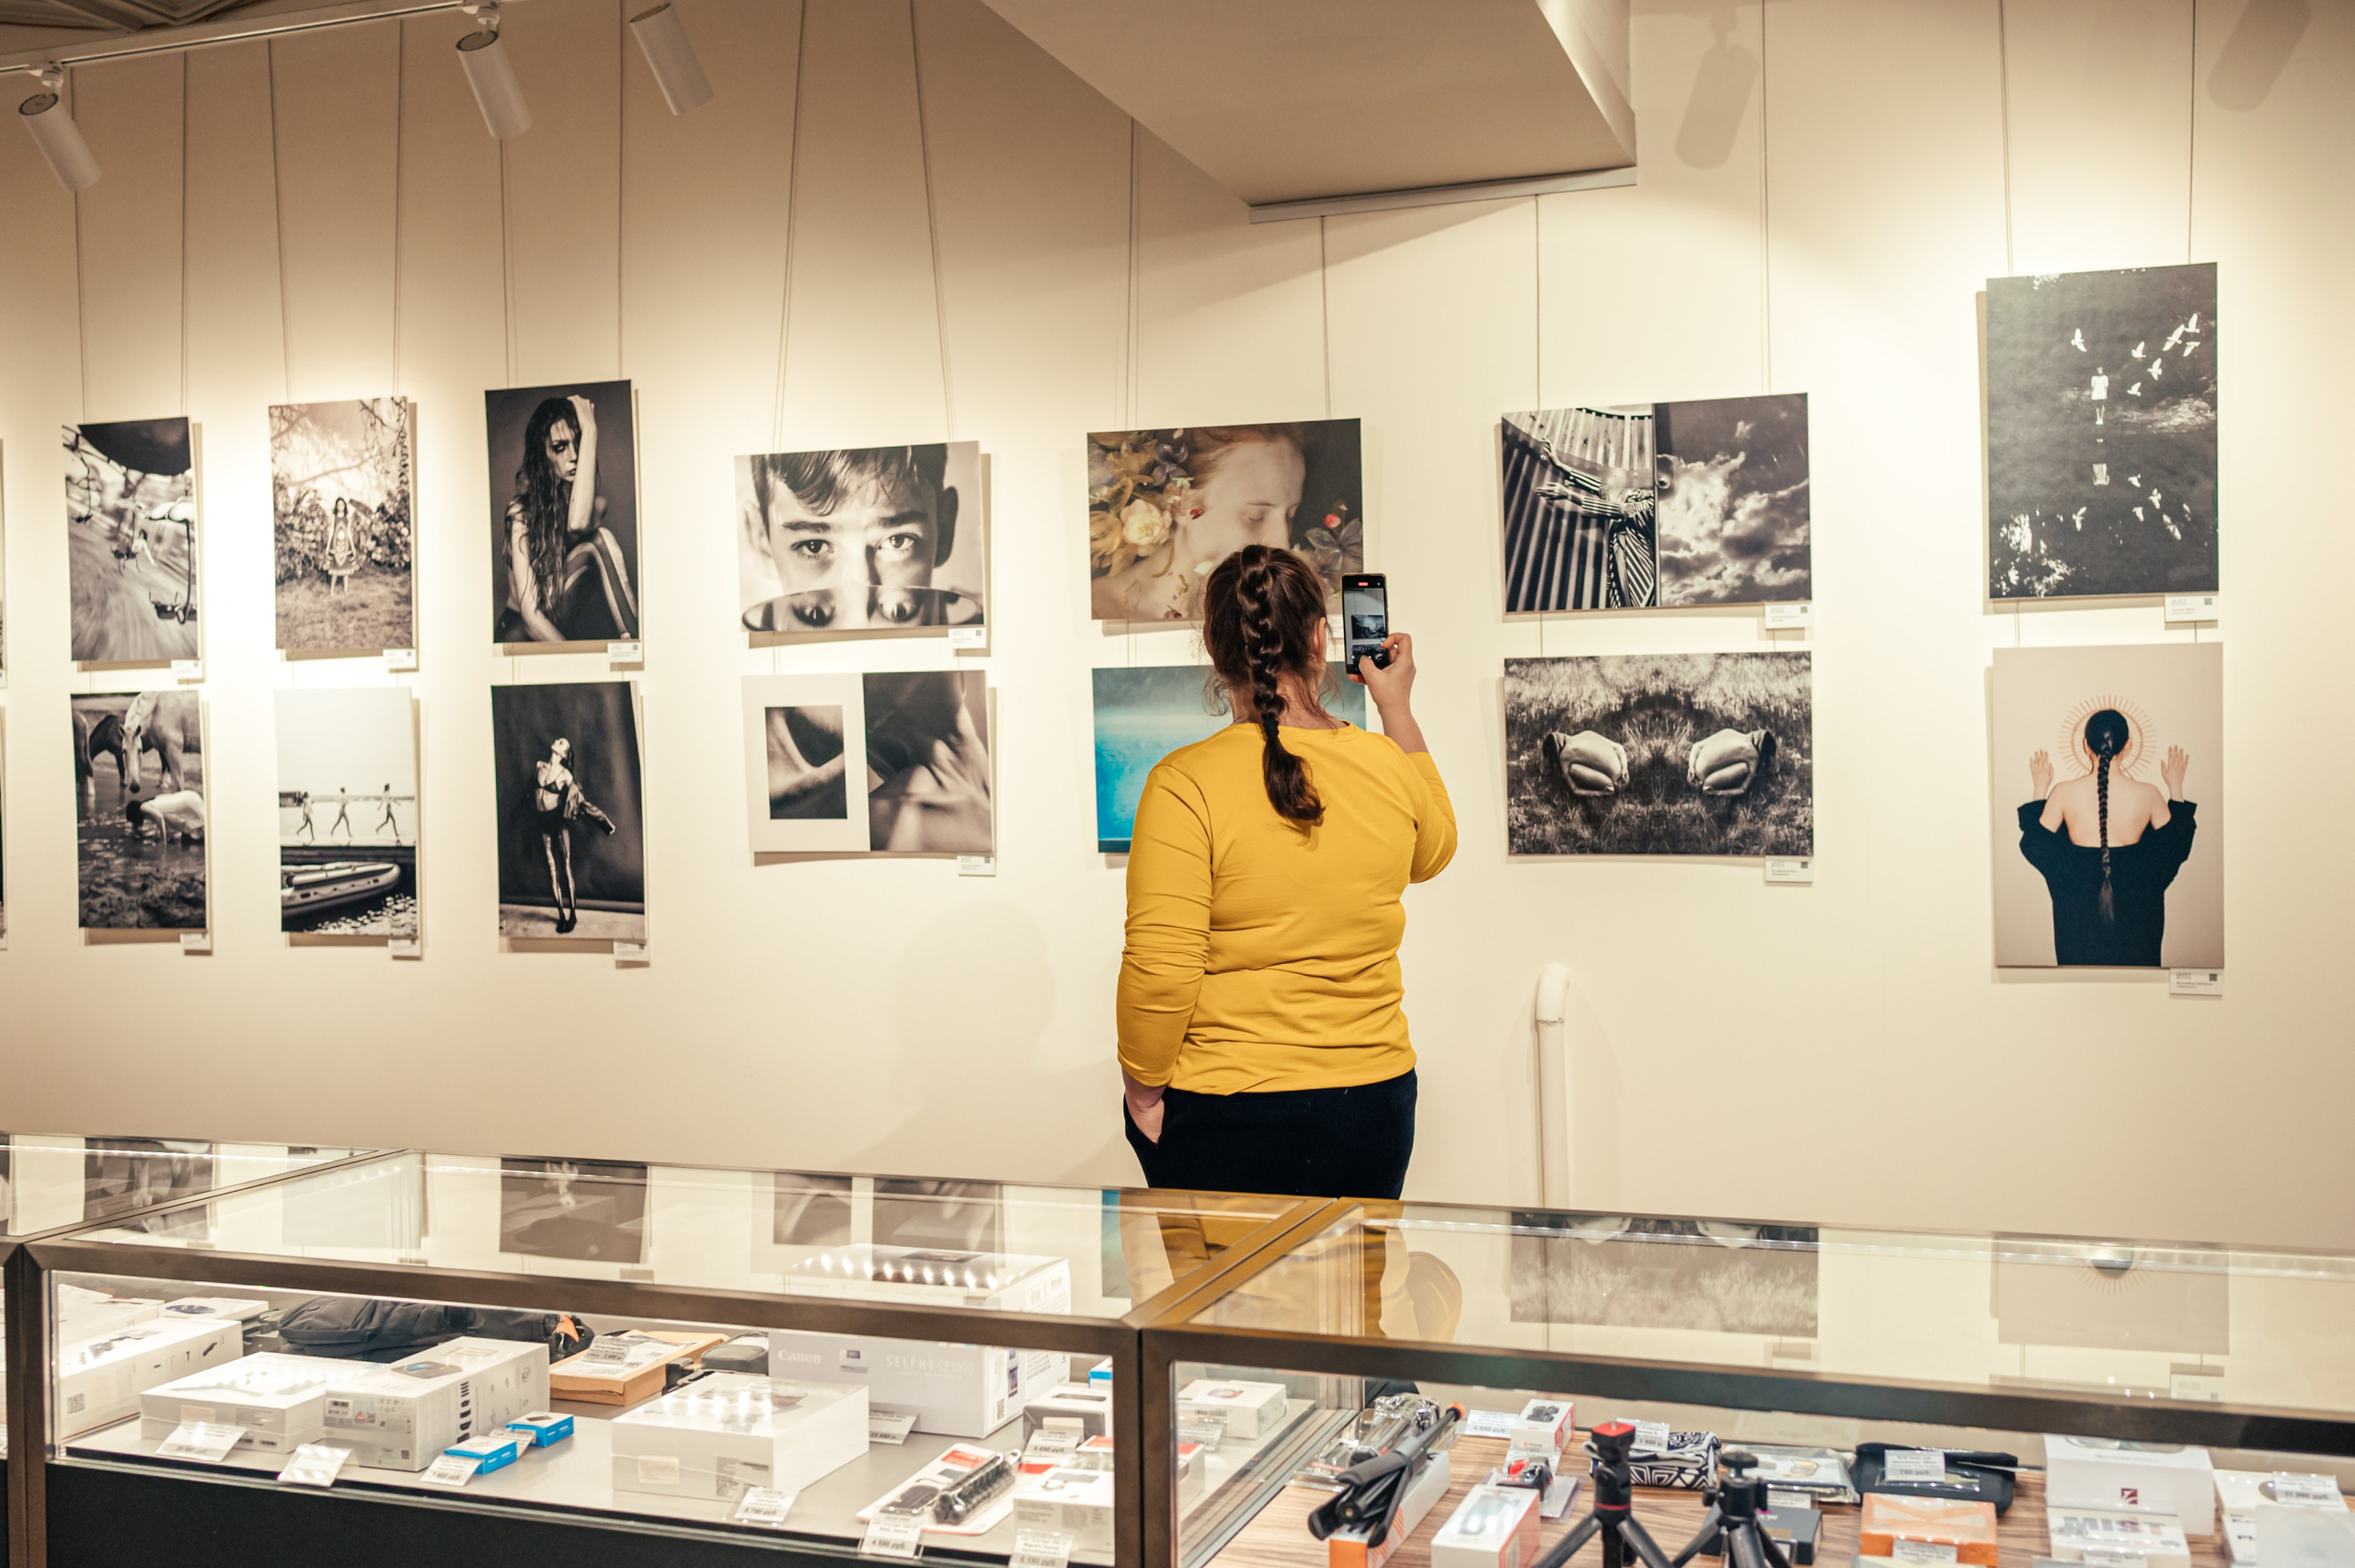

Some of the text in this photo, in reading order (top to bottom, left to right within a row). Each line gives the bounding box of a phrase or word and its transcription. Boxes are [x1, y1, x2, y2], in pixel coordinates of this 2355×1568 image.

[777, 1349, 821, 1364] Canon
[886, 1355, 975, 1374] SELPHY CP1000
[2063, 1516, 2166, 1536] MIST
